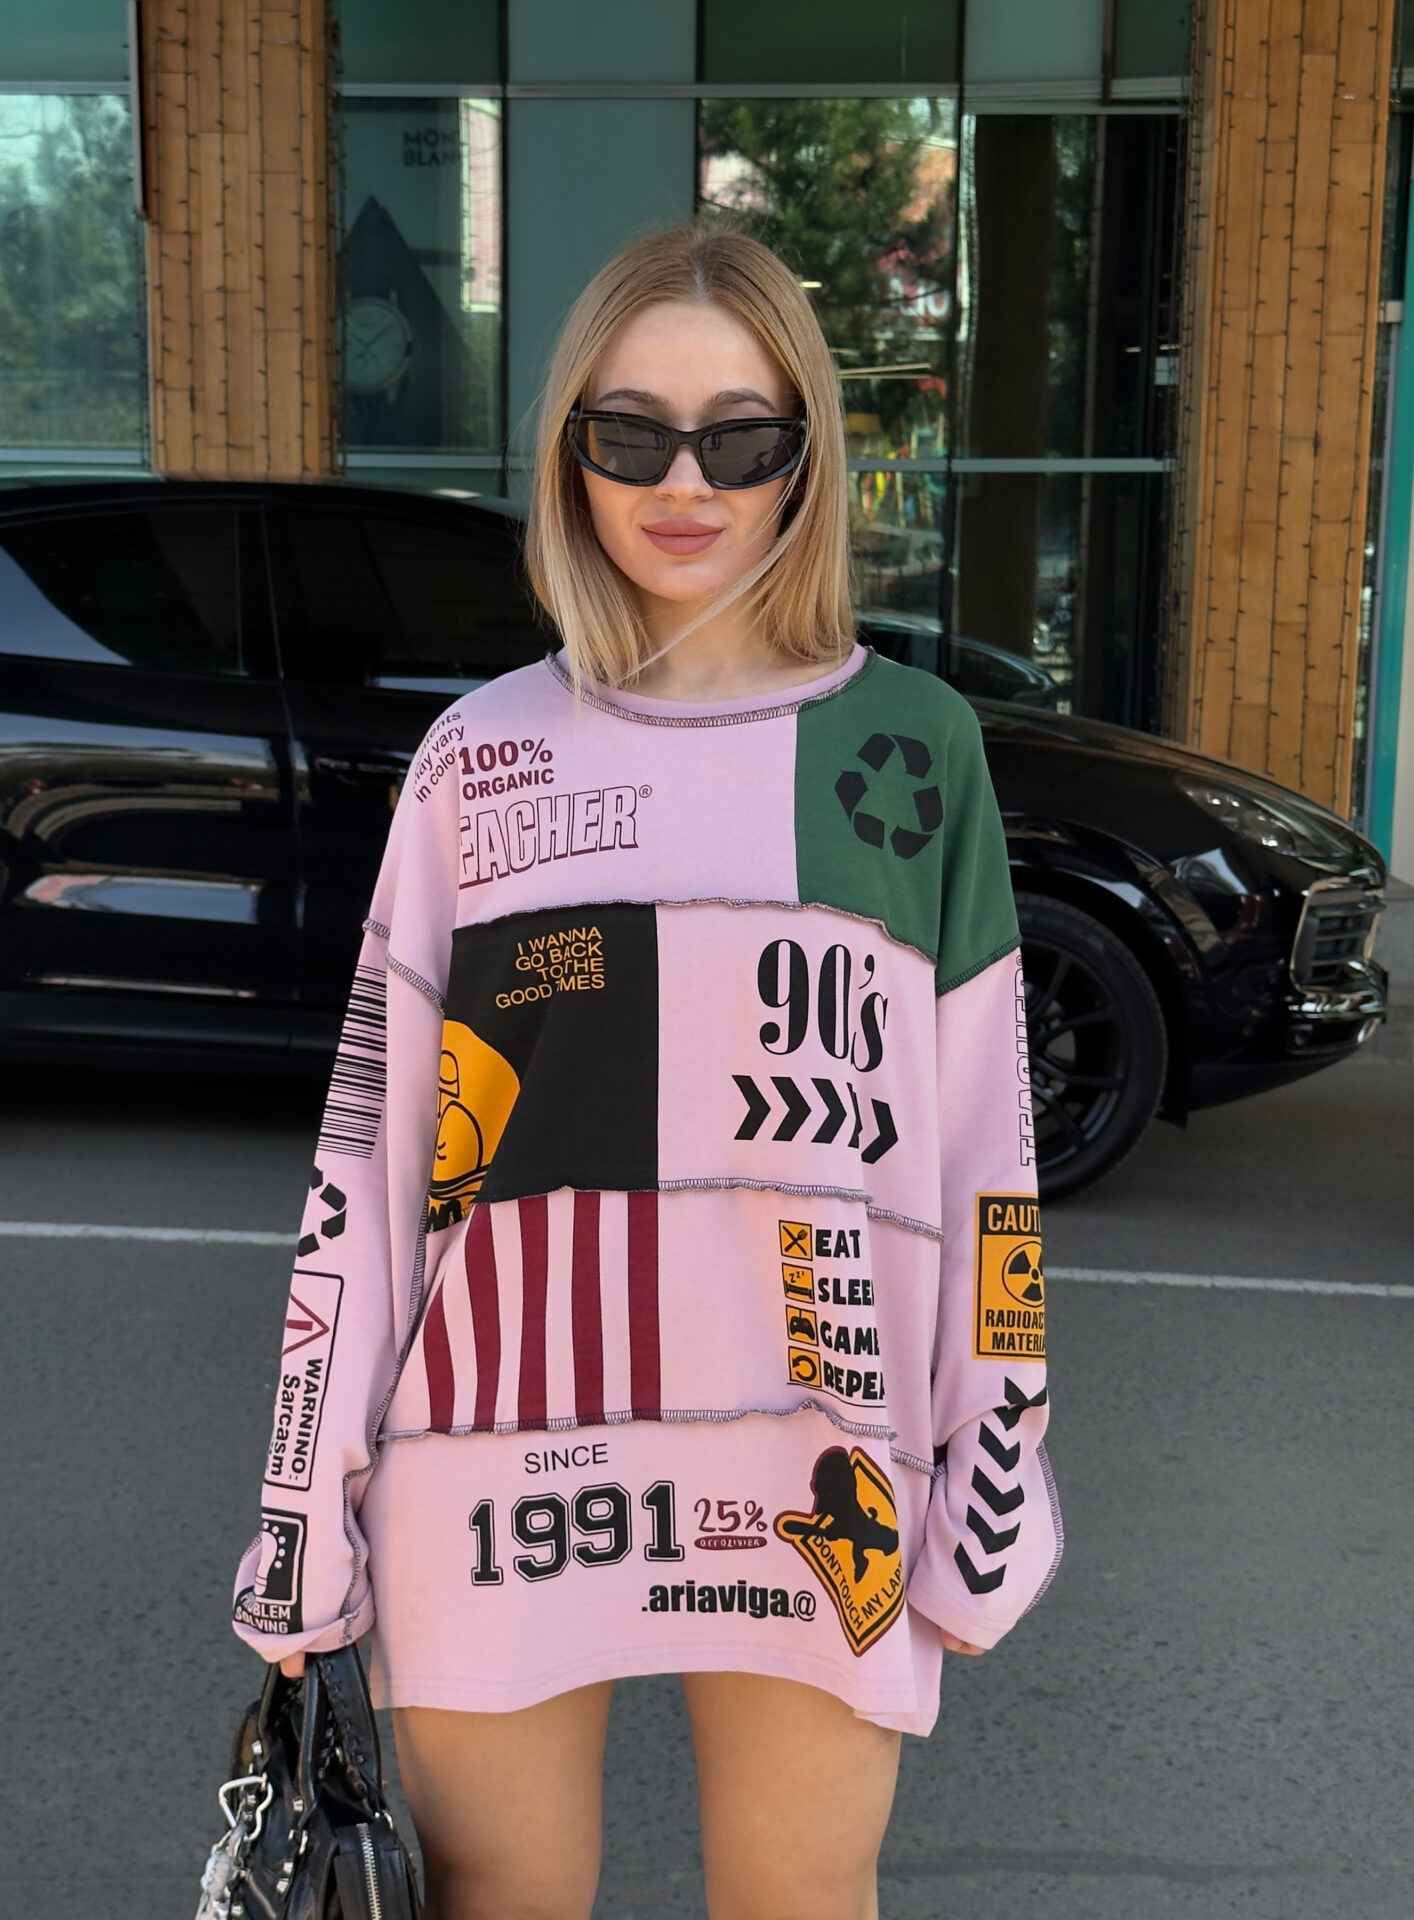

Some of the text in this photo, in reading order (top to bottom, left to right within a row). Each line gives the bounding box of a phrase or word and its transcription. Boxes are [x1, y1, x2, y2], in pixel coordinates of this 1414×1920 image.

[432, 725, 465, 755] vary
[458, 738, 554, 776] 100%
[416, 747, 457, 803] in color
[462, 768, 555, 800] ORGANIC
[515, 940, 603, 971] GO BACK
[517, 926, 603, 956] I WANNA
[536, 965, 563, 981] TO
[495, 983, 553, 1009] GOOD
[757, 938, 888, 1073] 90's
[815, 1229, 860, 1258] EAT
[817, 1277, 874, 1306] SLEE
[271, 1374, 301, 1476] Sarcasm
[524, 1443, 609, 1474] SINCE
[694, 1498, 768, 1533] 25%
[469, 1480, 685, 1586] 1991
[839, 1574, 864, 1630] TOUCH
[861, 1593, 884, 1620] MY
[235, 1606, 289, 1634] SOLVING
